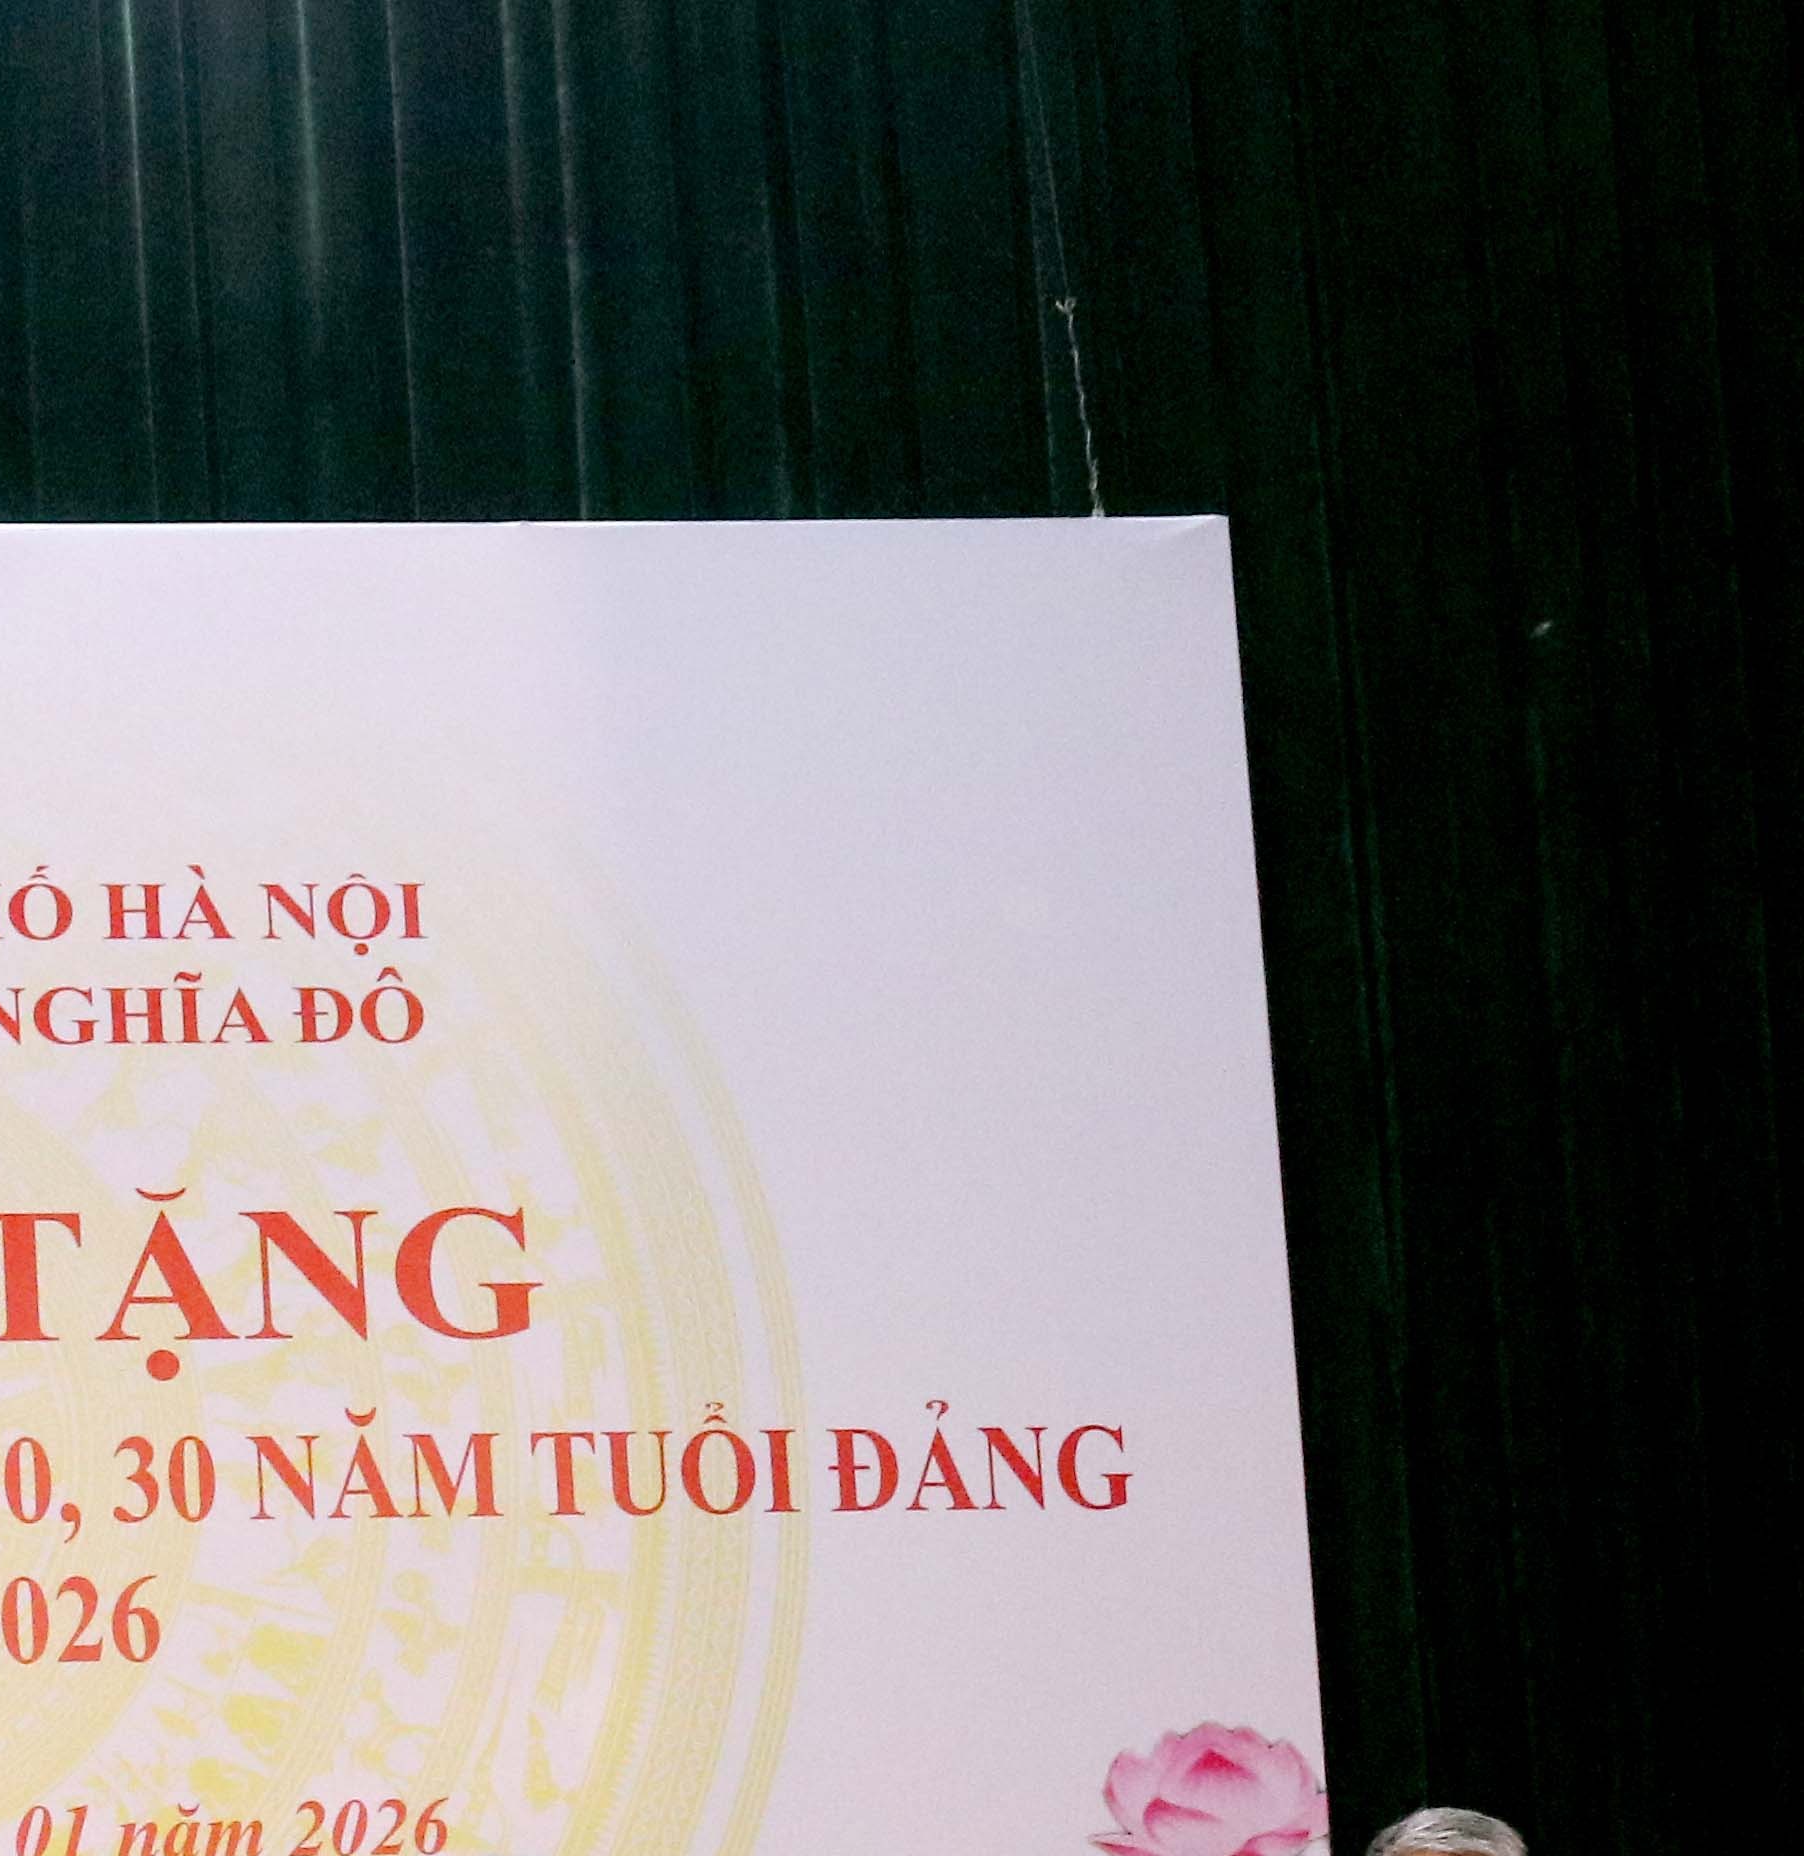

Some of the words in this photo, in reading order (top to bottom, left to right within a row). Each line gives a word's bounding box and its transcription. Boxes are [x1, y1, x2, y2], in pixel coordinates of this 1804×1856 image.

[104, 863, 235, 940] HÀ
[262, 870, 428, 957] NỘI
[295, 965, 427, 1043] ĐÔ
[110, 1434, 219, 1524] 30
[246, 1407, 503, 1520] NĂM
[527, 1401, 800, 1517] TUỔI
[825, 1400, 1134, 1513] ĐẢNG
[287, 1797, 451, 1856] 2026
